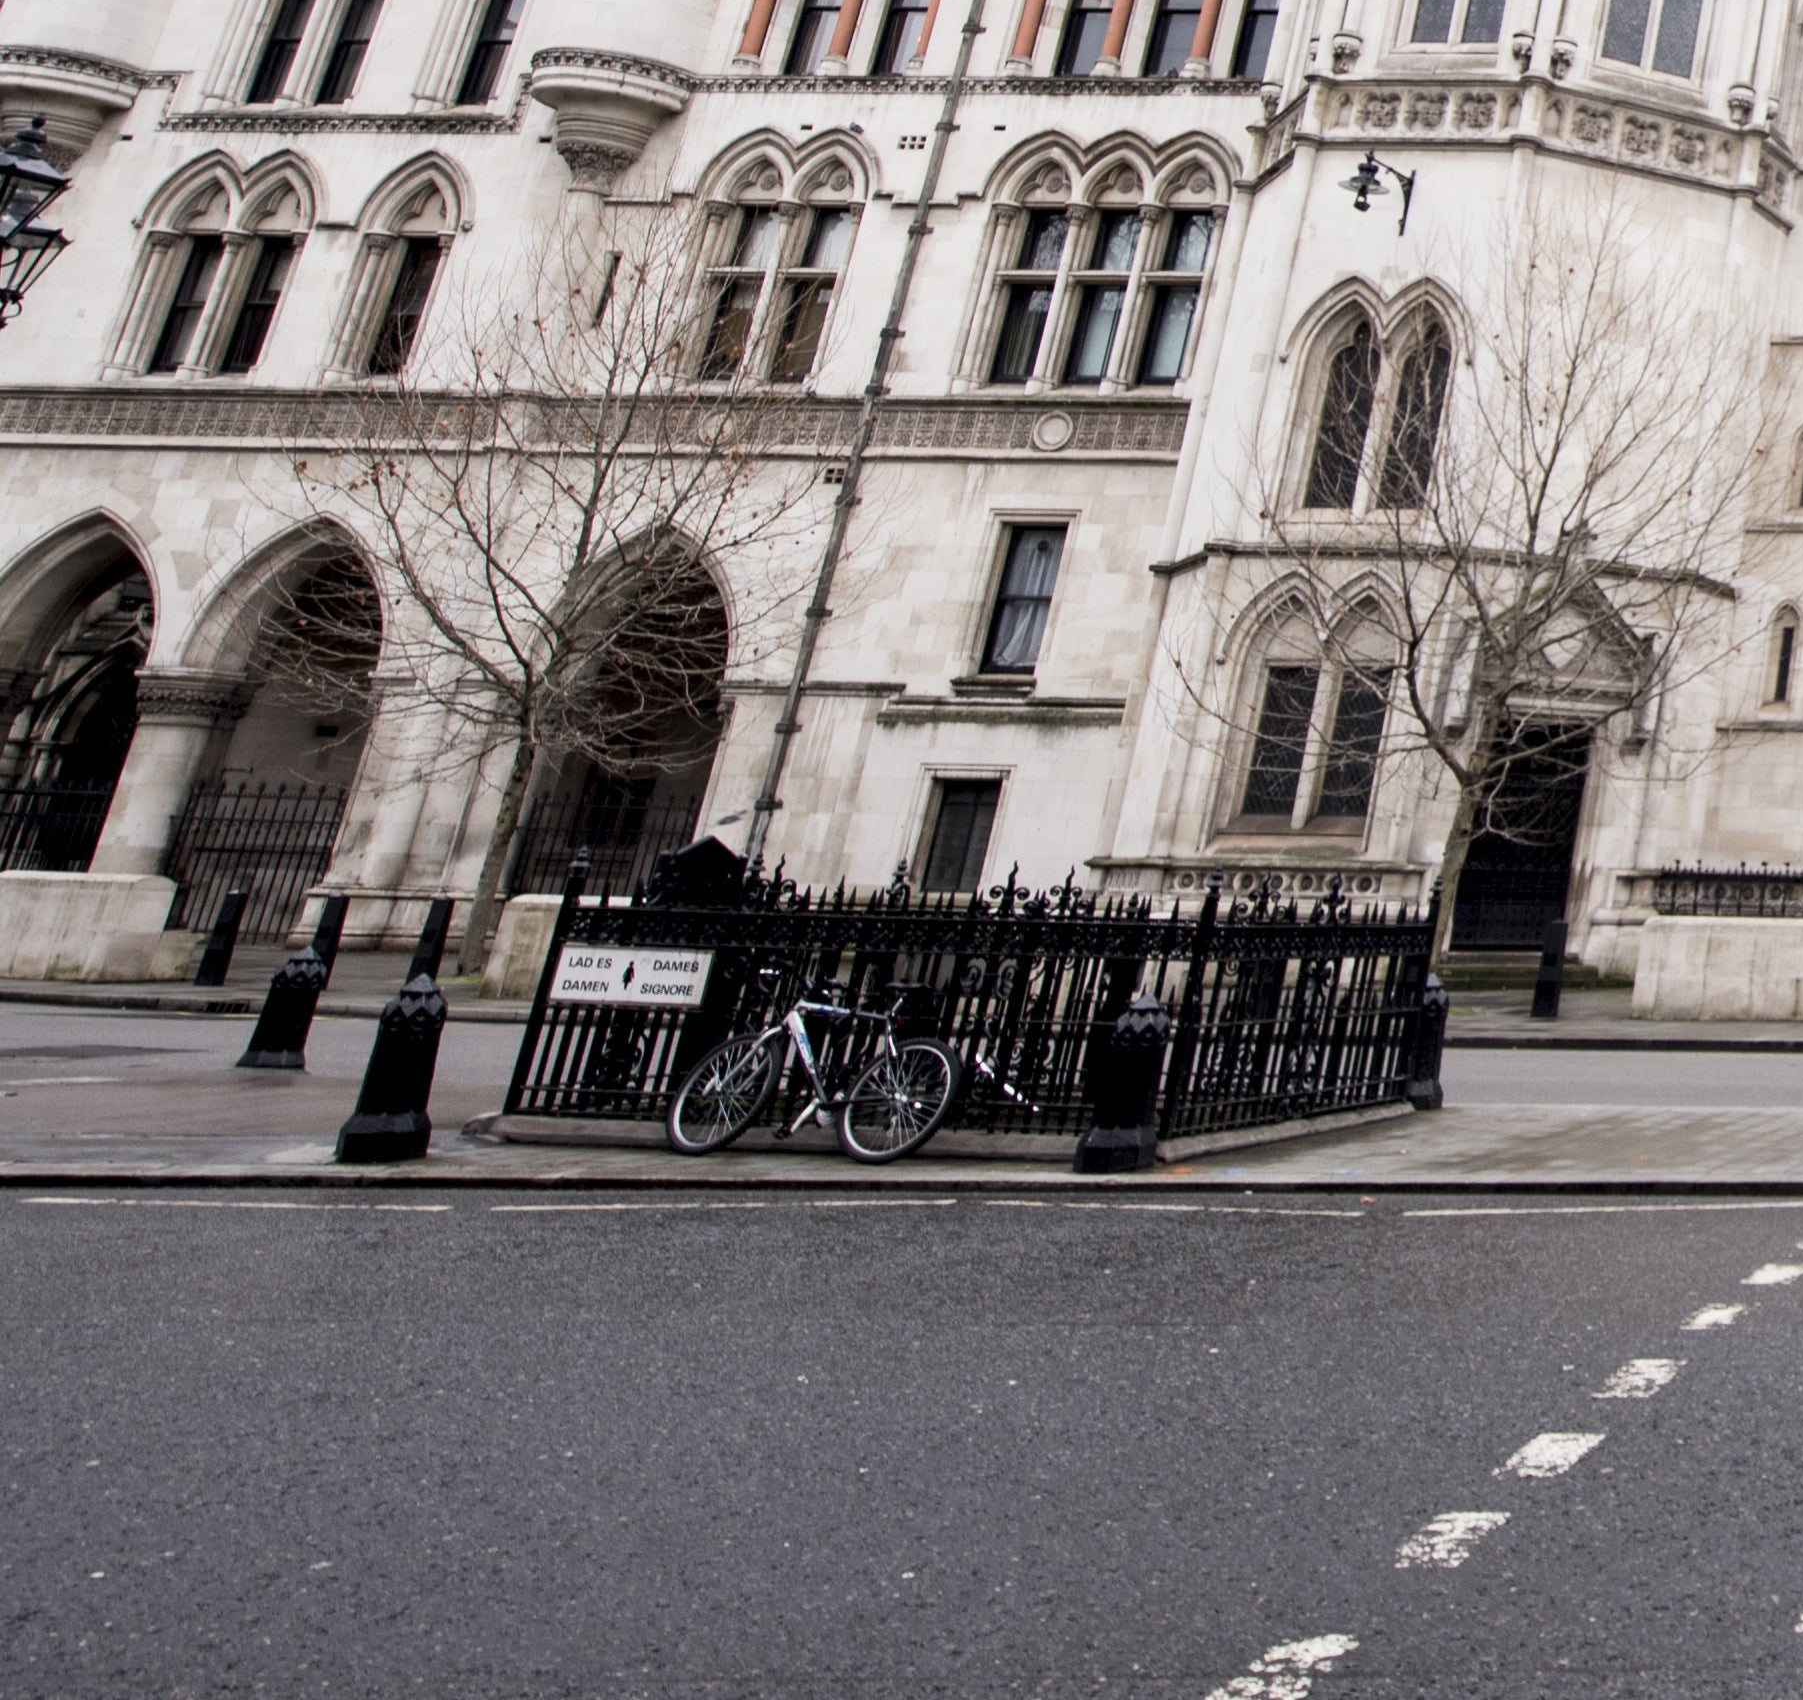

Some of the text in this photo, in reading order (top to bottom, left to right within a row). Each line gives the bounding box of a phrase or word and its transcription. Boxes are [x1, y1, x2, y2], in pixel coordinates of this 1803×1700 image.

[653, 959, 699, 973] DAMES
[562, 979, 609, 992] DAMEN
[640, 982, 695, 996] SIGNORE
